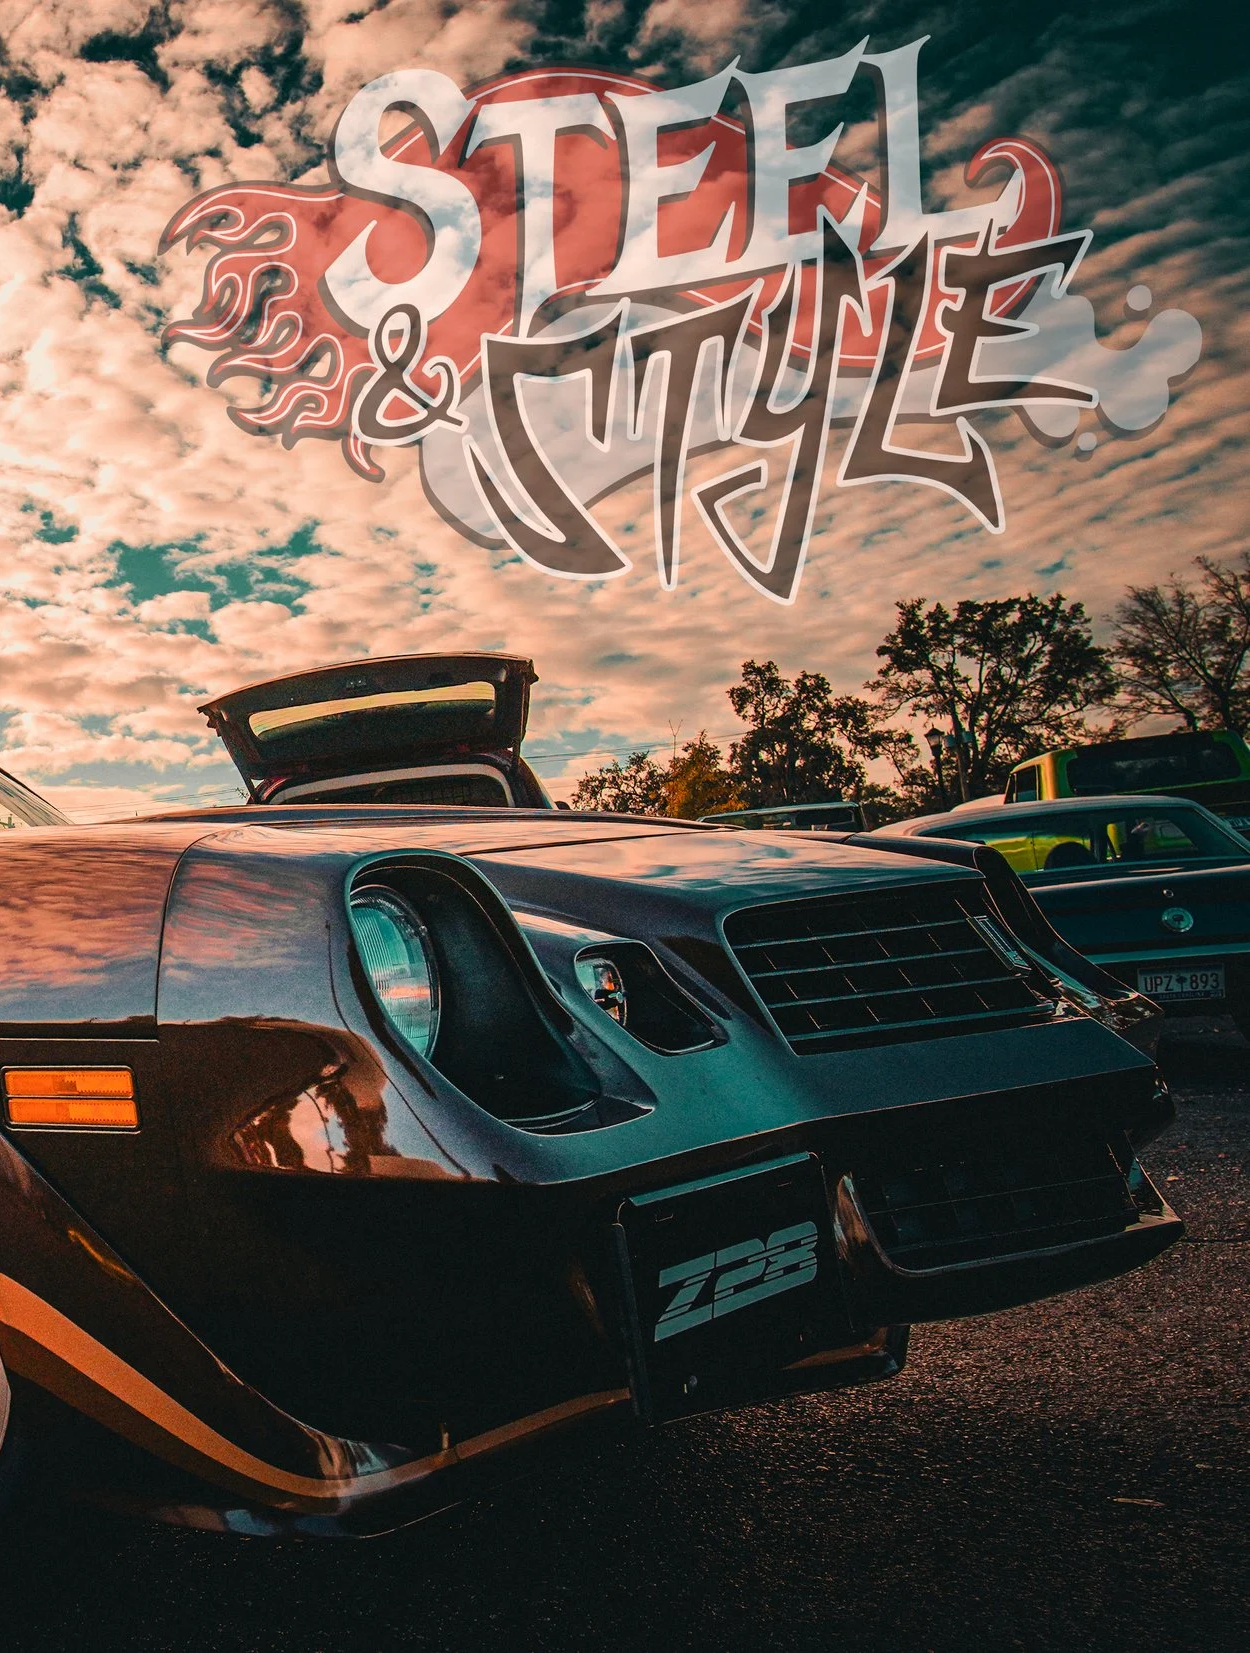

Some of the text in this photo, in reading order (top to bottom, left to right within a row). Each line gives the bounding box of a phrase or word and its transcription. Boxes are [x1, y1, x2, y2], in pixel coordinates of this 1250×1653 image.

[1143, 972, 1220, 993] UPZ 893
[653, 1219, 819, 1343] Z28
